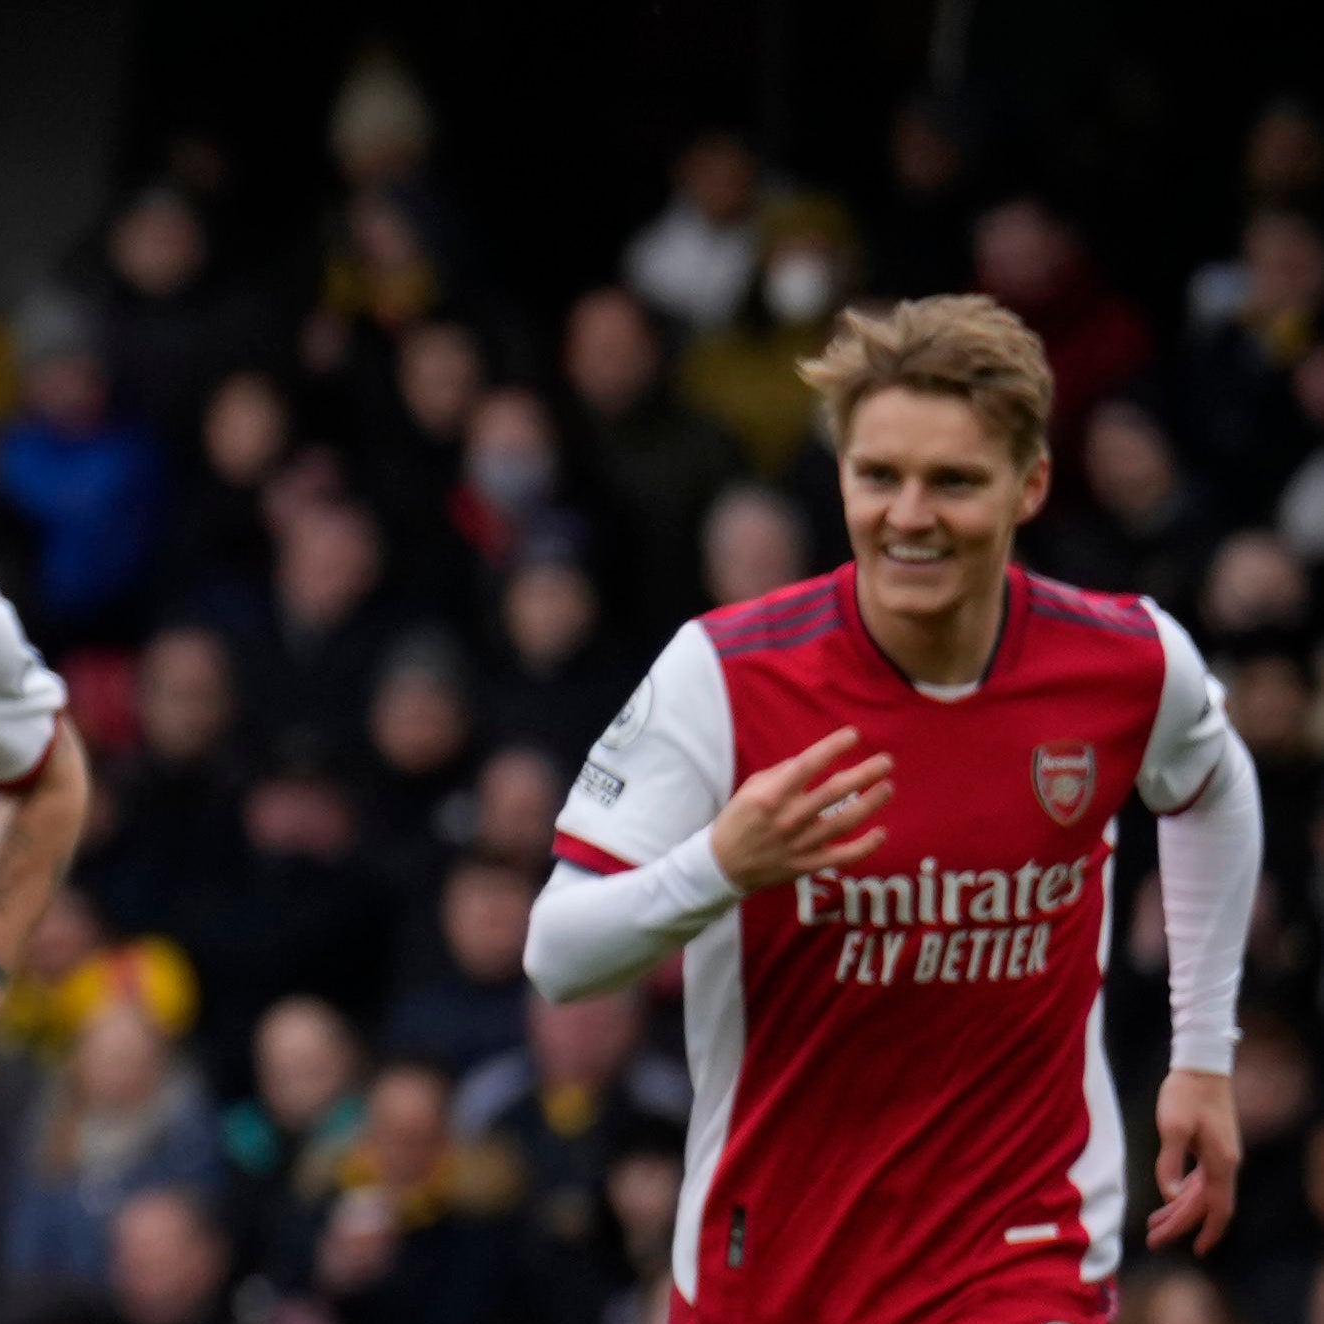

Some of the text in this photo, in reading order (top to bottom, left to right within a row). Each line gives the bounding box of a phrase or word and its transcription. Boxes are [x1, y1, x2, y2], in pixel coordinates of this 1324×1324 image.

[794, 855, 1089, 929] Emirates
[833, 922, 1052, 987] FLY BETTER
